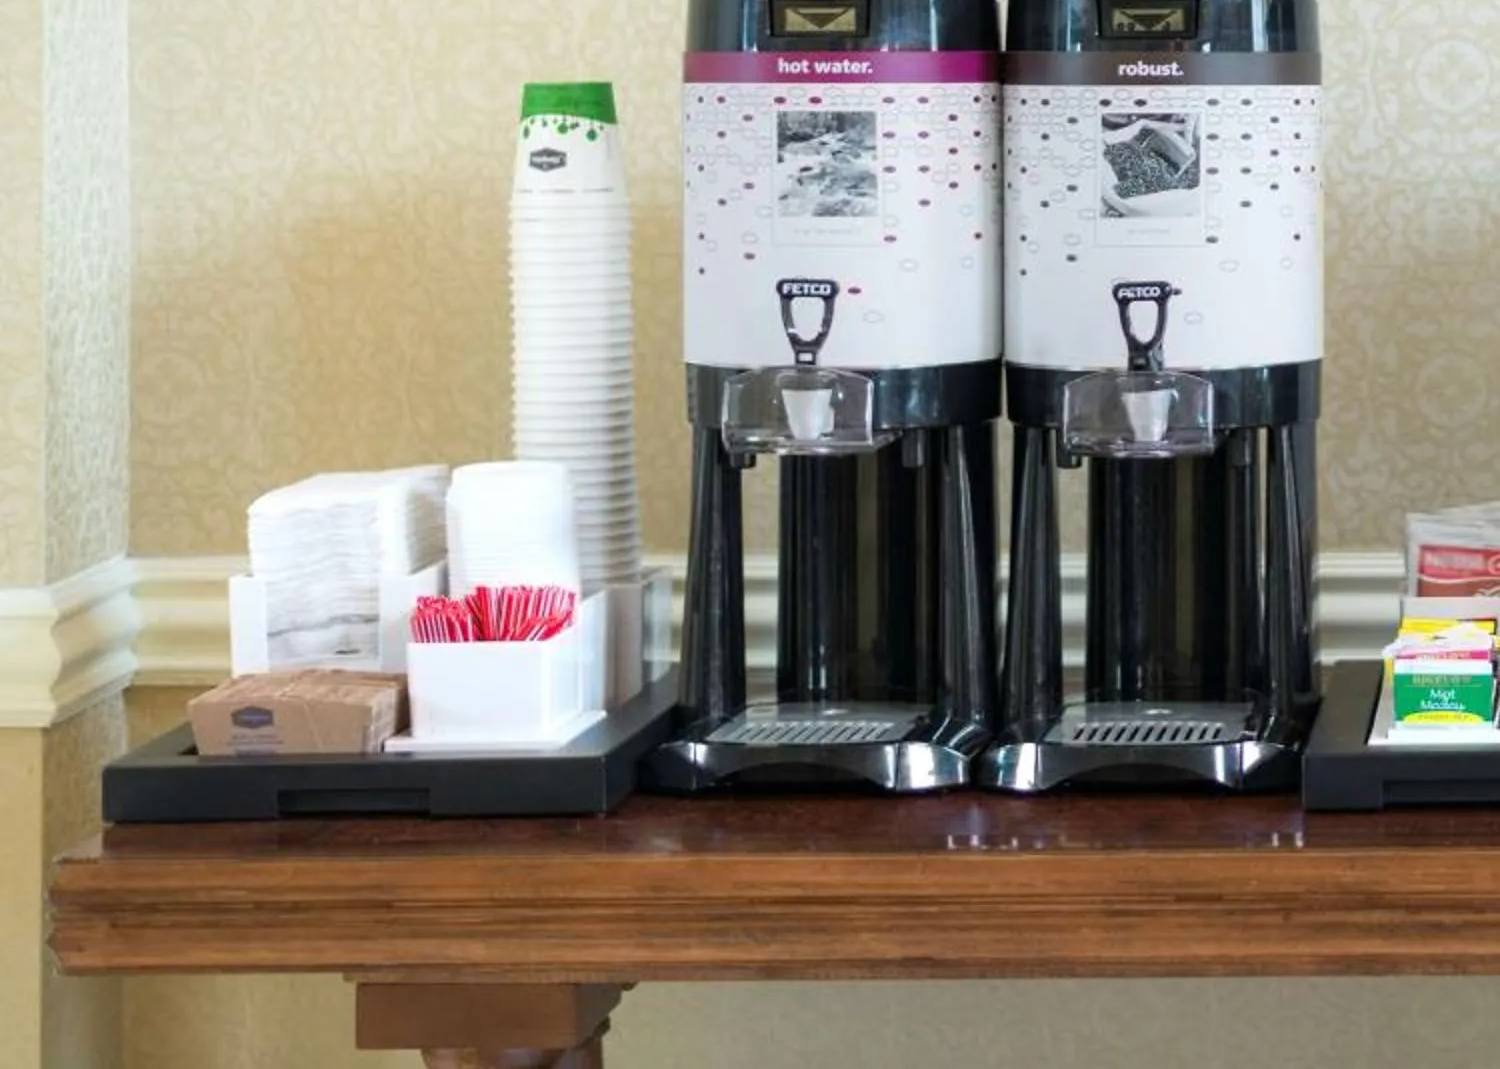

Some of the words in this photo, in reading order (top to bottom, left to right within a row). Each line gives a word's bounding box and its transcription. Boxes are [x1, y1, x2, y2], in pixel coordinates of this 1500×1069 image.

[778, 57, 810, 74] hot
[814, 58, 873, 74] water.
[1118, 60, 1184, 76] robust.
[782, 282, 831, 296] FETCO
[1117, 286, 1161, 299] FETCO
